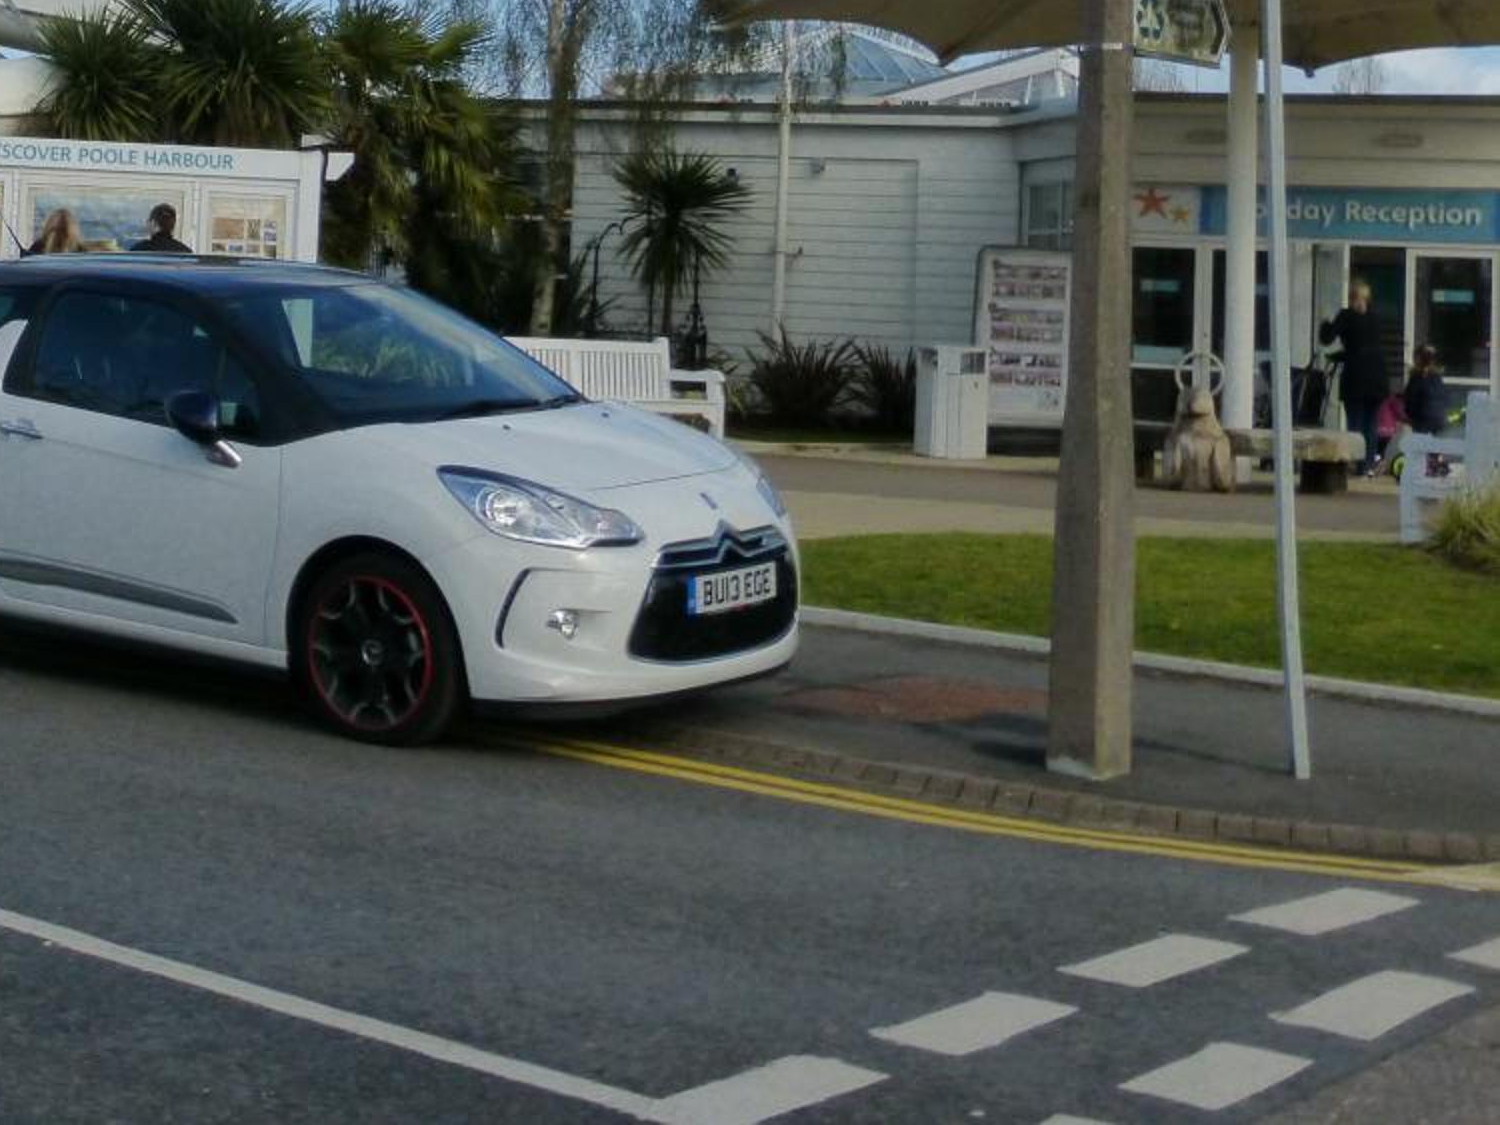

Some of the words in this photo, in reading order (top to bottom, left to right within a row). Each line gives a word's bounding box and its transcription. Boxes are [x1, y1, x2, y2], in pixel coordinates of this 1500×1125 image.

[78, 148, 137, 165] POOLE
[144, 153, 234, 170] HARBOUR
[1345, 201, 1481, 230] Reception
[703, 575, 740, 605] BU13
